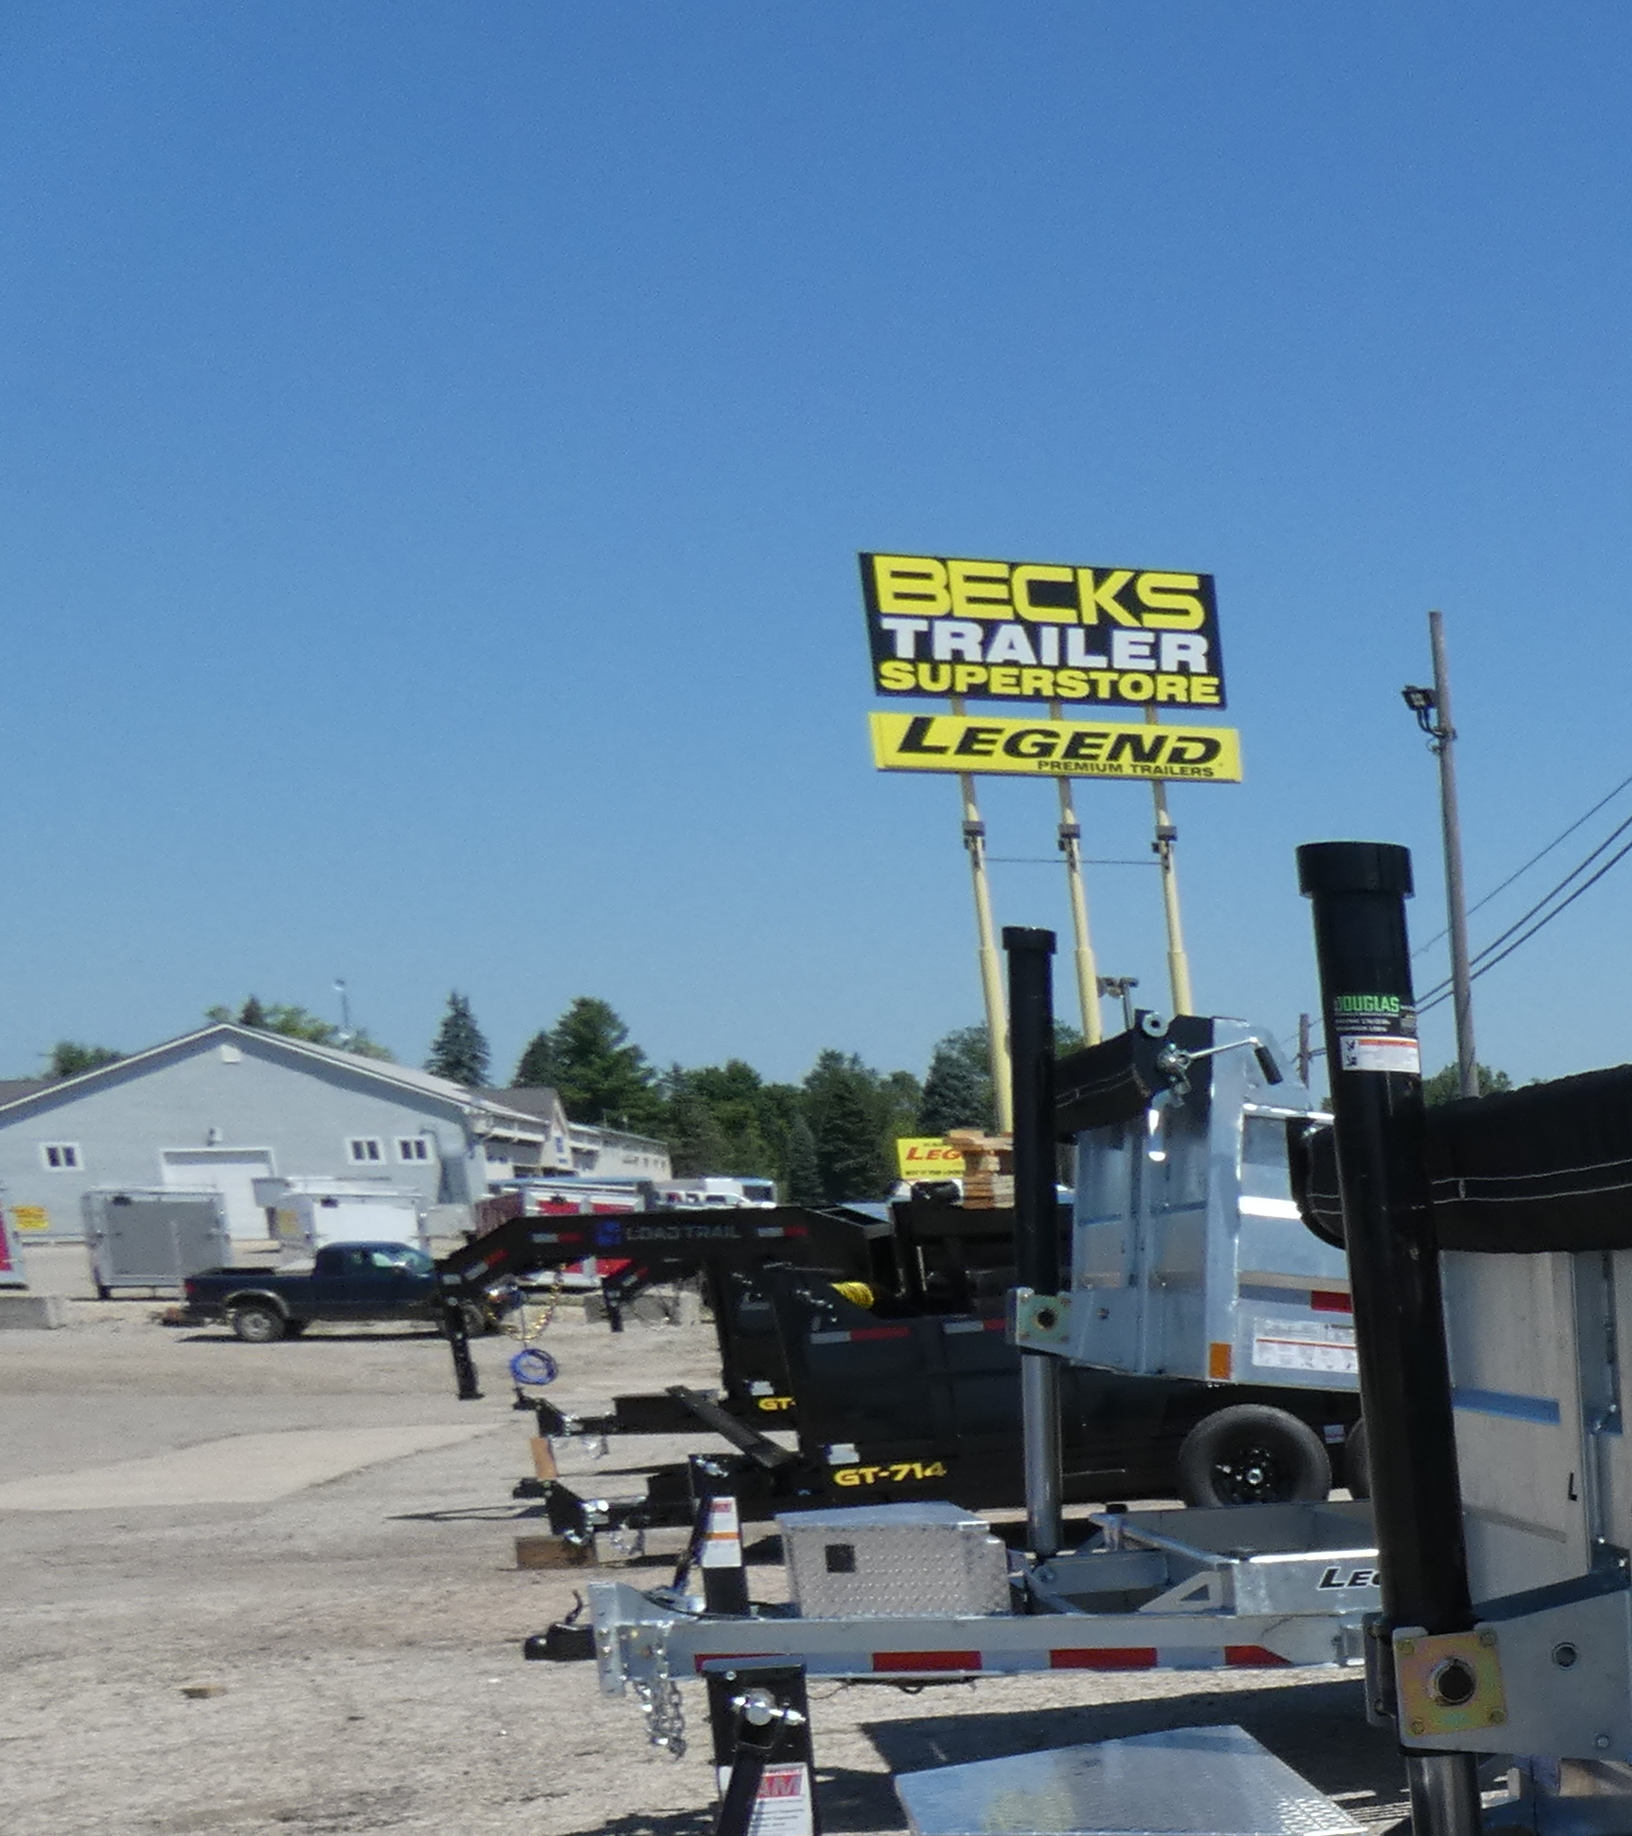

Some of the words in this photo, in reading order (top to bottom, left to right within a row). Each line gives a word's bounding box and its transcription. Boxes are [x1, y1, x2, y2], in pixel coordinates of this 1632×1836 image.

[873, 555, 1205, 631] BECKS
[881, 615, 1209, 673] TRAILER
[879, 660, 1221, 704] SUPERSTORE
[896, 716, 1222, 765] LEGEND
[1037, 759, 1123, 774] PREMIUM
[1129, 763, 1215, 778] TRAILERS
[905, 1147, 962, 1161] LEG
[758, 1396, 796, 1411] GT-
[833, 1462, 948, 1487] GT-714
